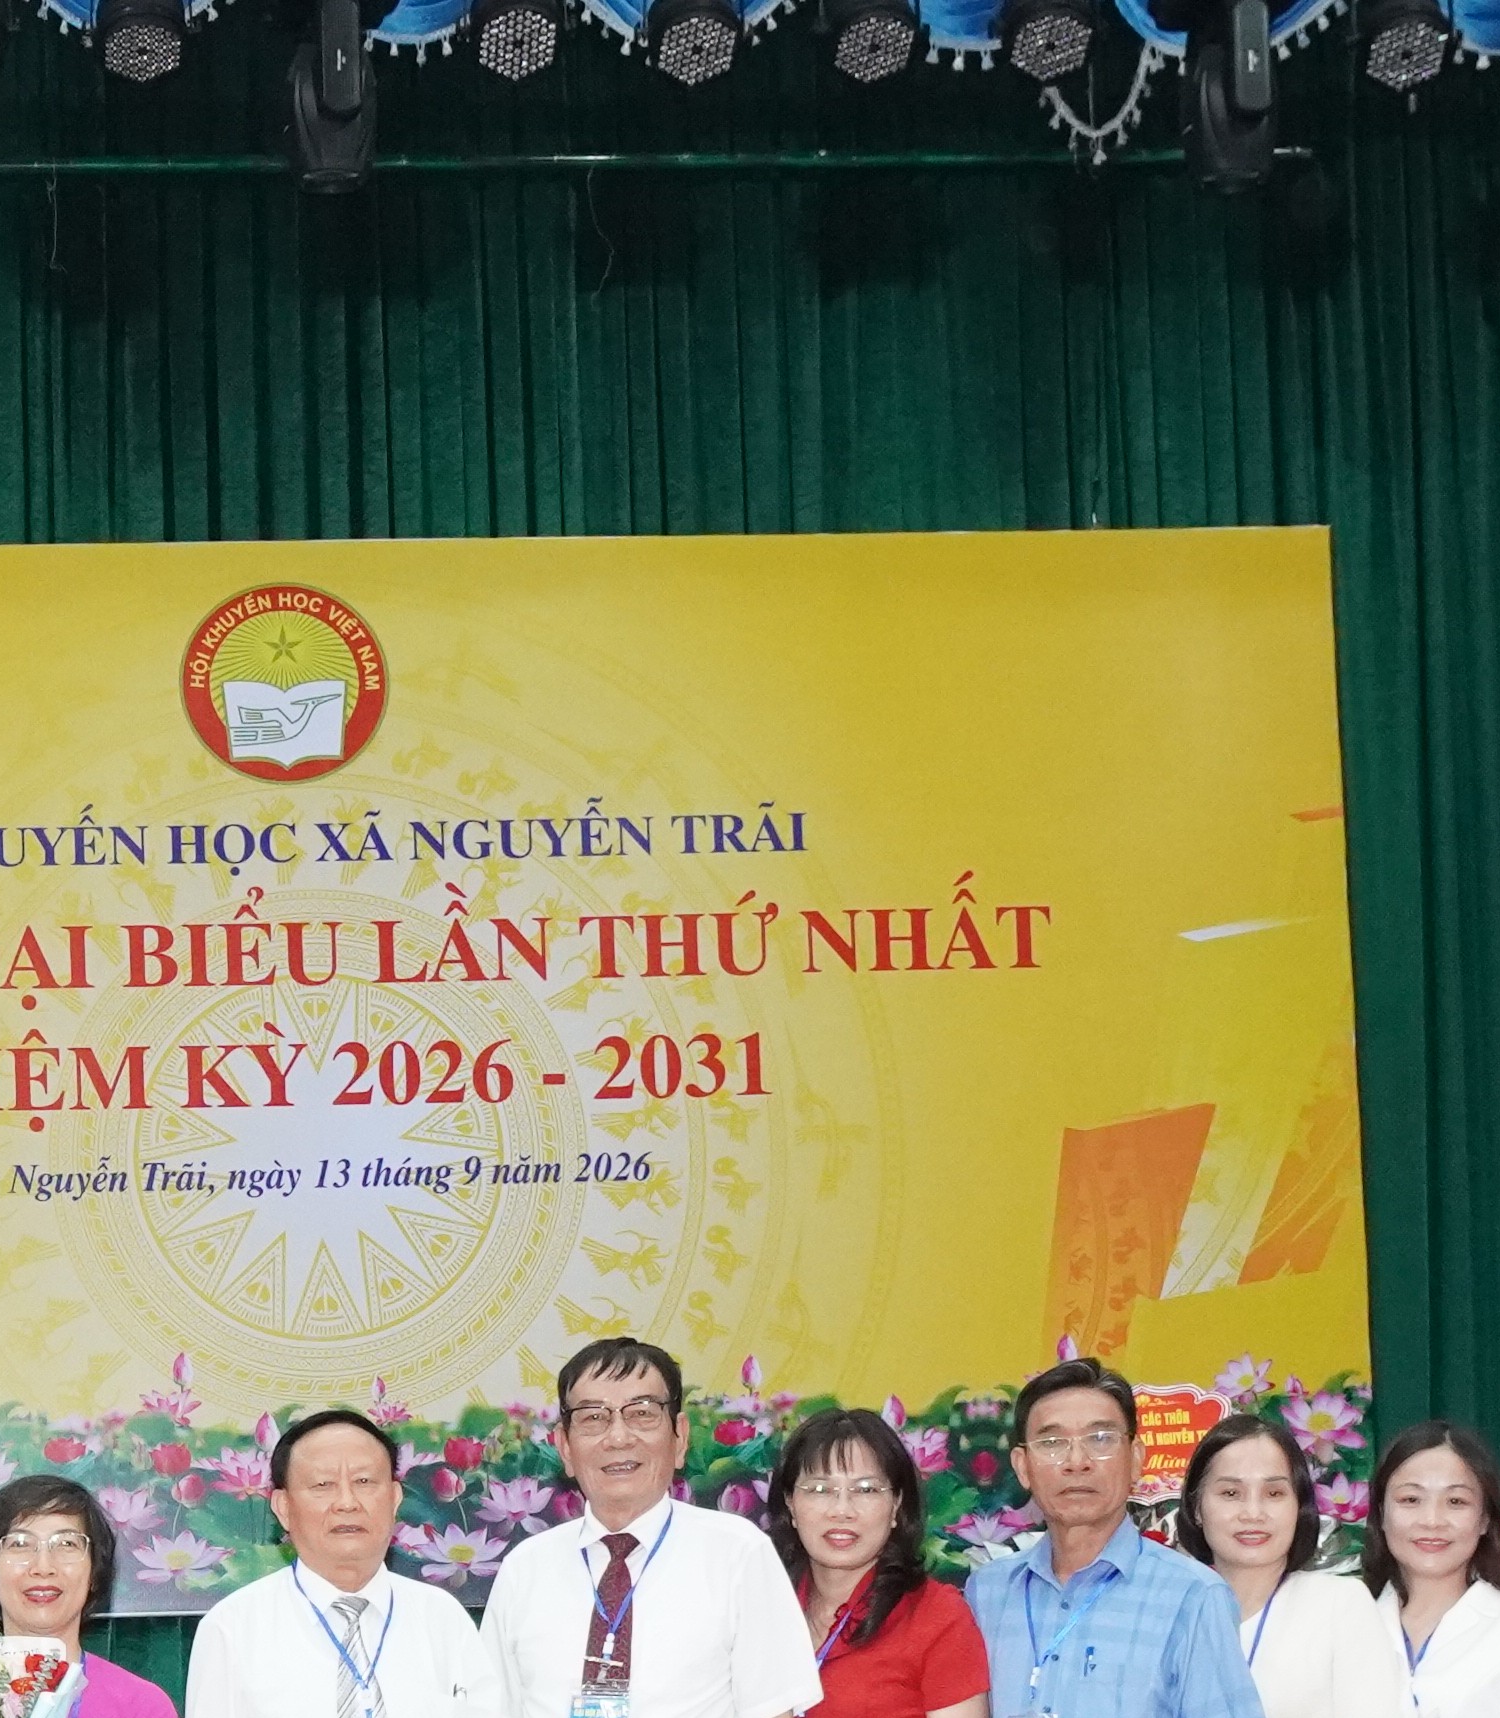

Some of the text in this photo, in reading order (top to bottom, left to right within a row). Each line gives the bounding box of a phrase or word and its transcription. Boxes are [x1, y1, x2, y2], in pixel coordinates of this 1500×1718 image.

[190, 593, 380, 691] HỘI KHUYẾN HỌC VIỆT NAM
[166, 823, 297, 877] HỌC
[314, 810, 394, 863] XÃ
[409, 796, 653, 861] NGUYỄN
[671, 801, 807, 854] TRÃI
[121, 886, 342, 988] BIỂU
[370, 882, 552, 983] LẦN
[579, 889, 779, 979] THỨ
[800, 870, 1051, 973] NHẤT
[179, 1021, 306, 1108] KỲ
[332, 1039, 515, 1107] 2026
[542, 1073, 567, 1085] -
[594, 1032, 773, 1100] 2031
[8, 1154, 128, 1201] Nguyễn
[142, 1160, 216, 1195] Trãi,
[227, 1160, 302, 1198] ngày
[313, 1158, 351, 1189] 13
[361, 1156, 454, 1195] tháng
[464, 1155, 482, 1184] 9
[492, 1154, 561, 1185] năm
[574, 1151, 653, 1182] 2026
[1141, 1408, 1190, 1427] CÁC THÔN
[1142, 1454, 1191, 1470] Mừn
